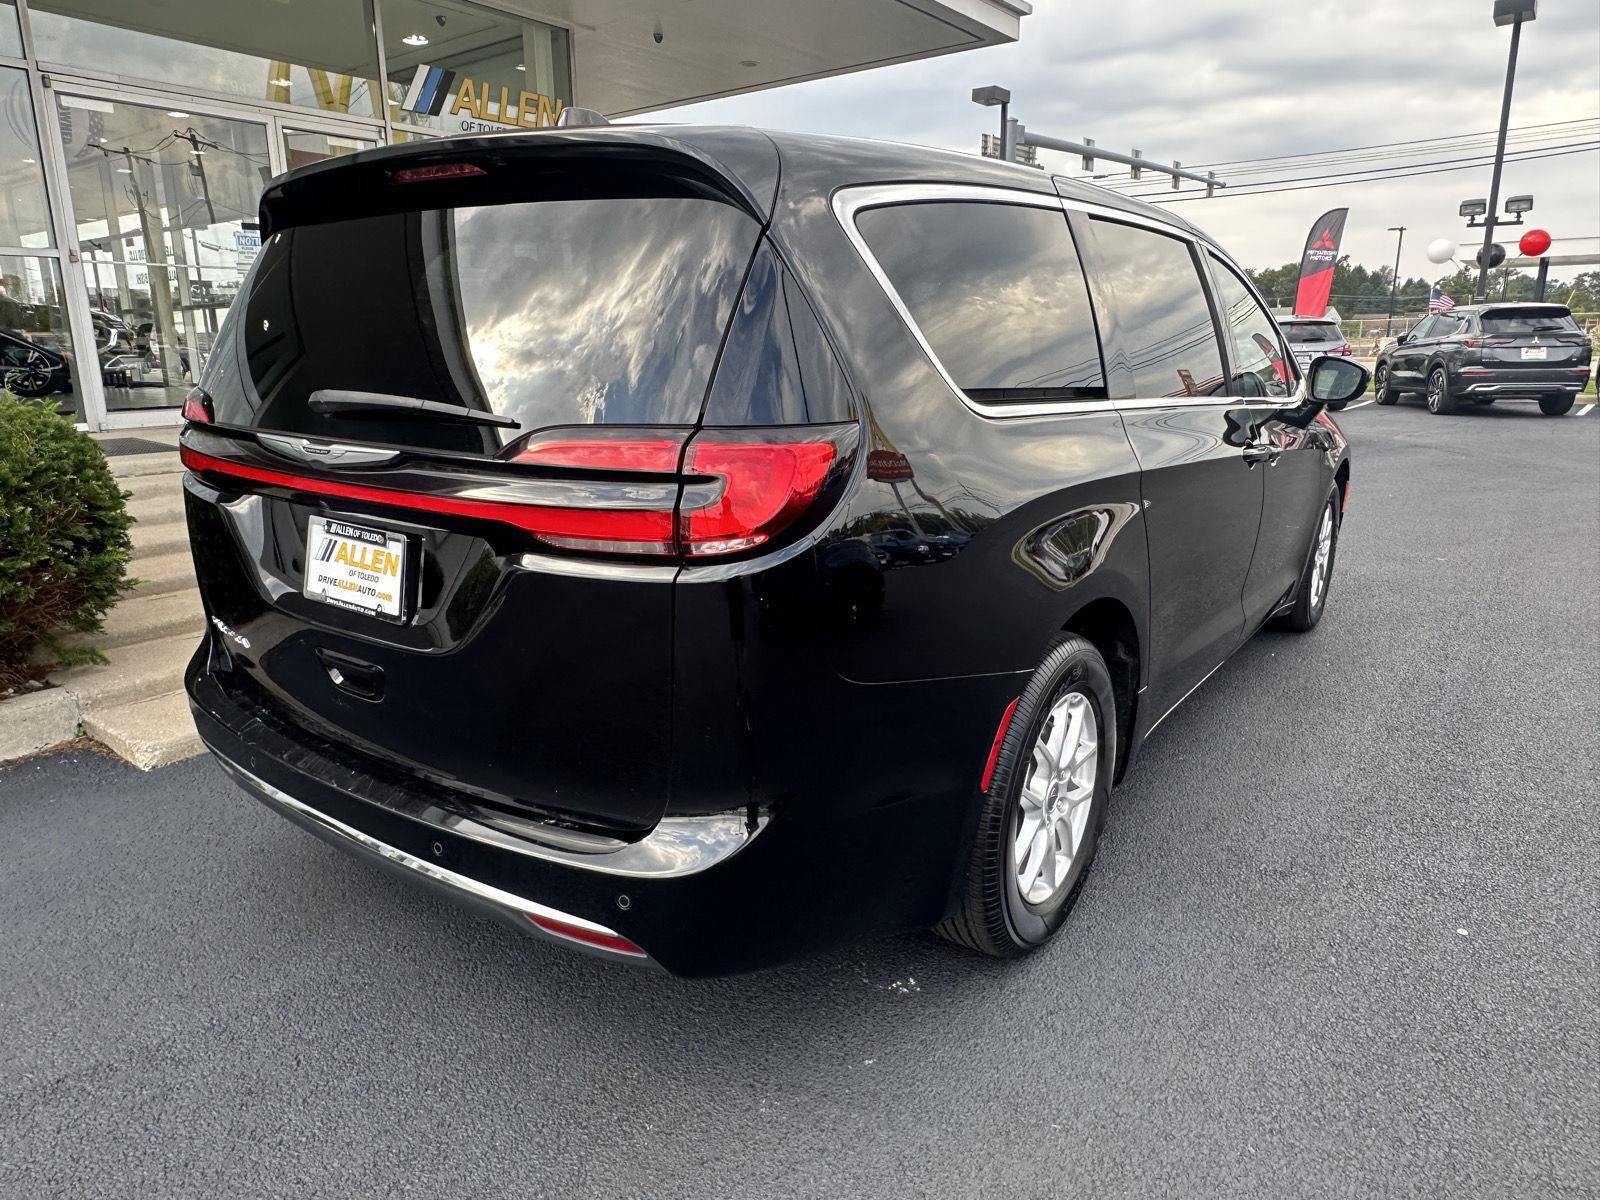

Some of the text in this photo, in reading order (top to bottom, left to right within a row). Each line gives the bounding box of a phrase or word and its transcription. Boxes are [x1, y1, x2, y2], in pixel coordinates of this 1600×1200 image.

[450, 78, 563, 128] ALLEN
[461, 120, 507, 132] OF TOL
[239, 236, 260, 246] NOTI
[335, 523, 353, 537] ALLEN
[353, 528, 361, 538] OF
[335, 541, 400, 577] ALLEN
[348, 569, 380, 583] OF TOLEDO
